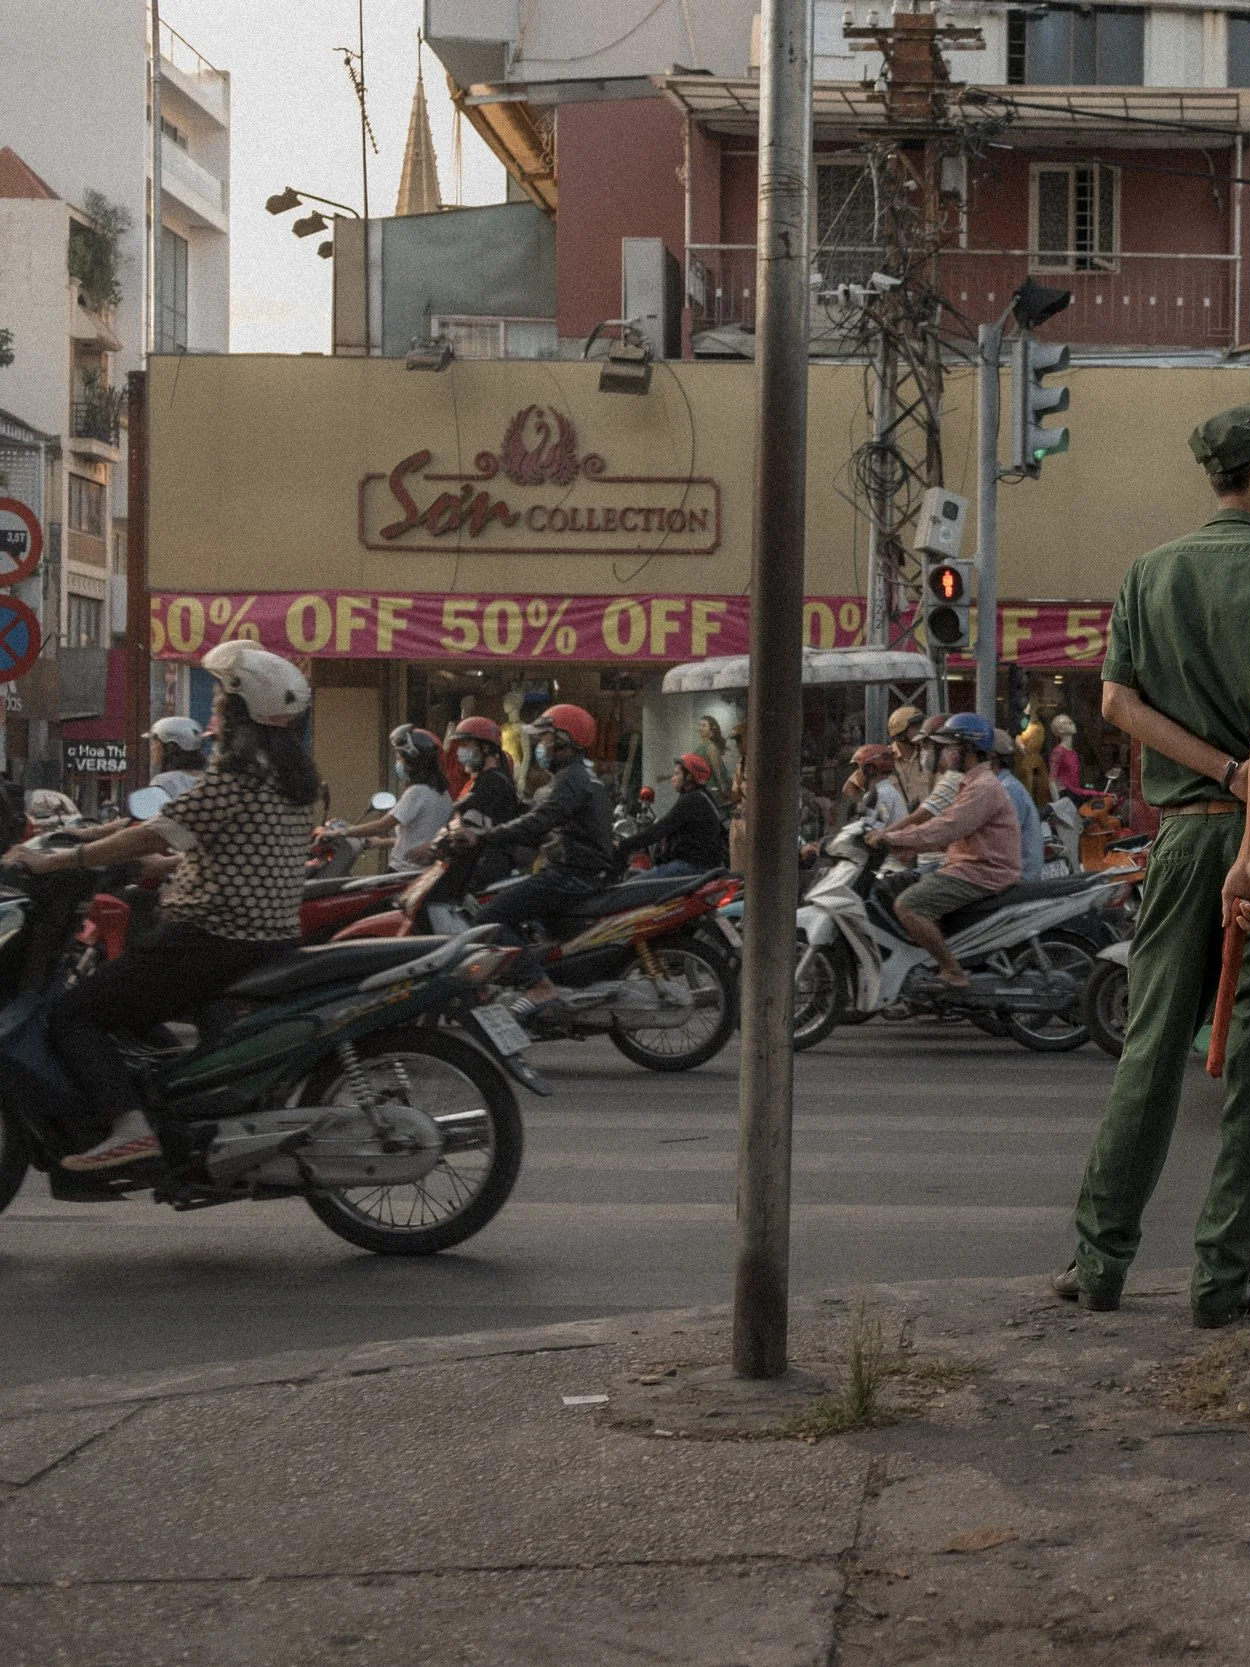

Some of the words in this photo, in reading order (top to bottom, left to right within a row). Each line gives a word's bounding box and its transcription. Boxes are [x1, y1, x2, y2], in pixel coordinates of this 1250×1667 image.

[526, 504, 709, 533] COLLECTION
[285, 595, 414, 653] OFF
[440, 598, 577, 656] 50%
[602, 599, 728, 657] OFF
